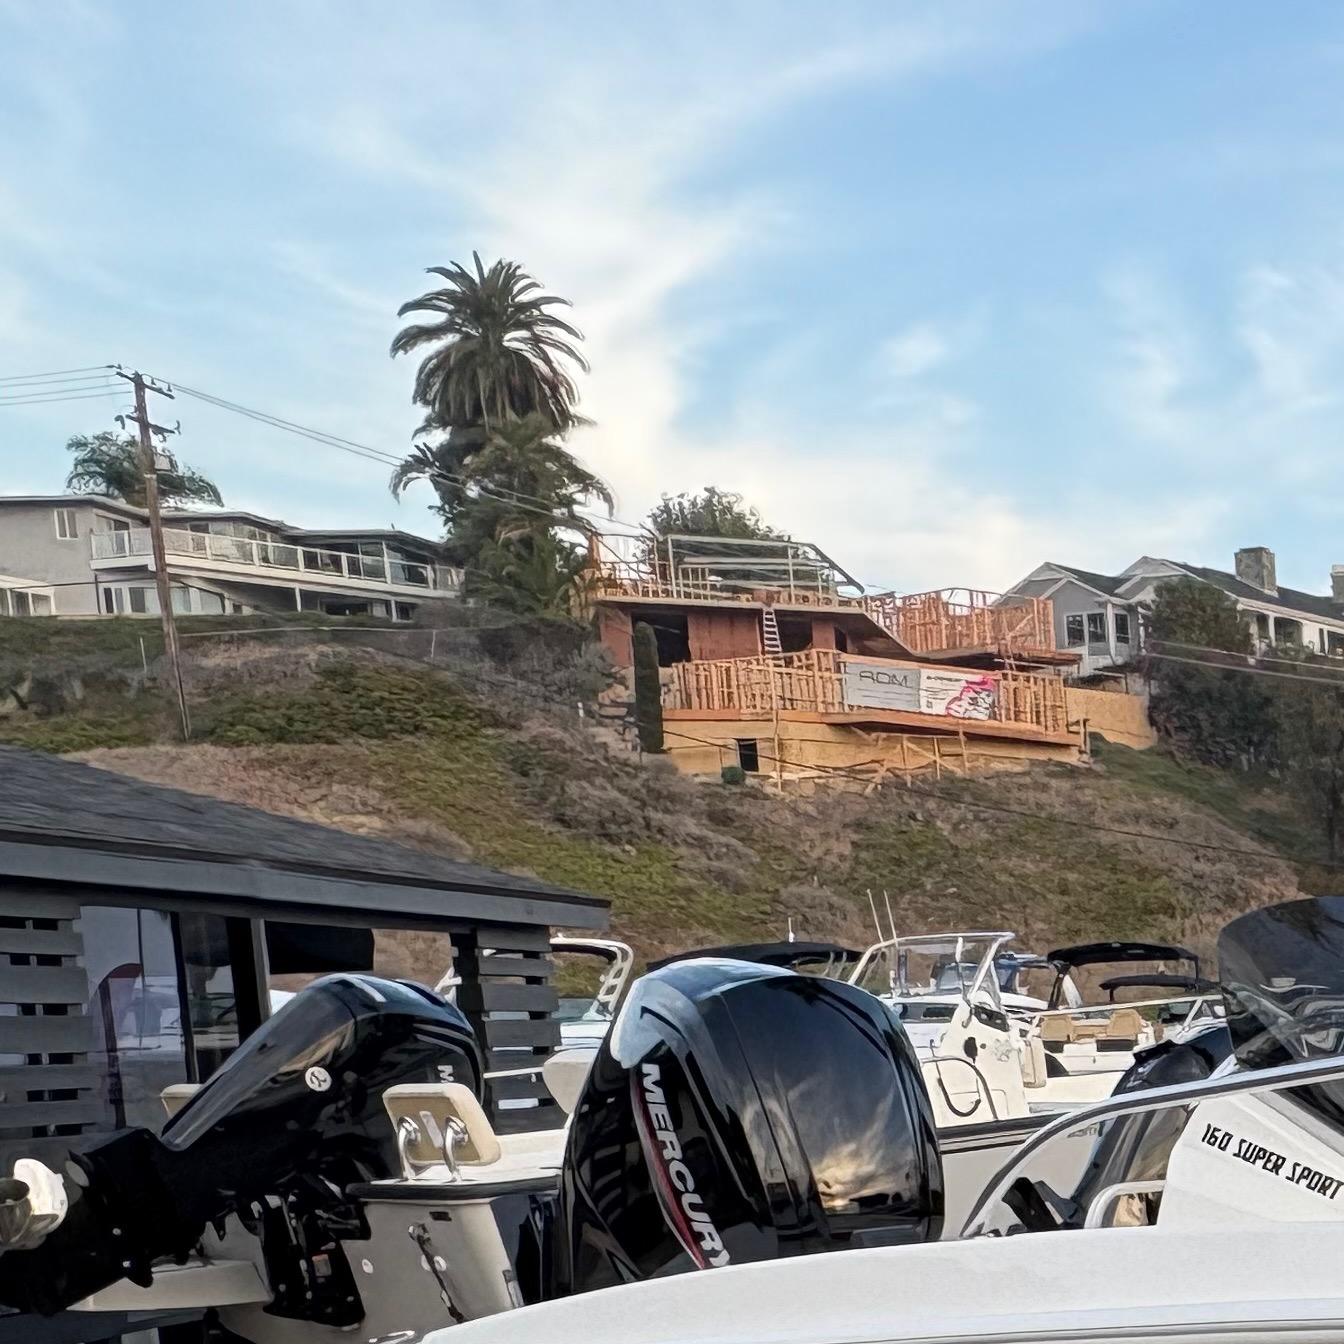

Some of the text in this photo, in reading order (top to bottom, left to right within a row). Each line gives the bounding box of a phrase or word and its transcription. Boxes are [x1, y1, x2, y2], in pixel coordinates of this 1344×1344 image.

[641, 1063, 731, 1267] MERCURY
[1201, 1123, 1234, 1151] 160
[1232, 1138, 1287, 1176] SUPER
